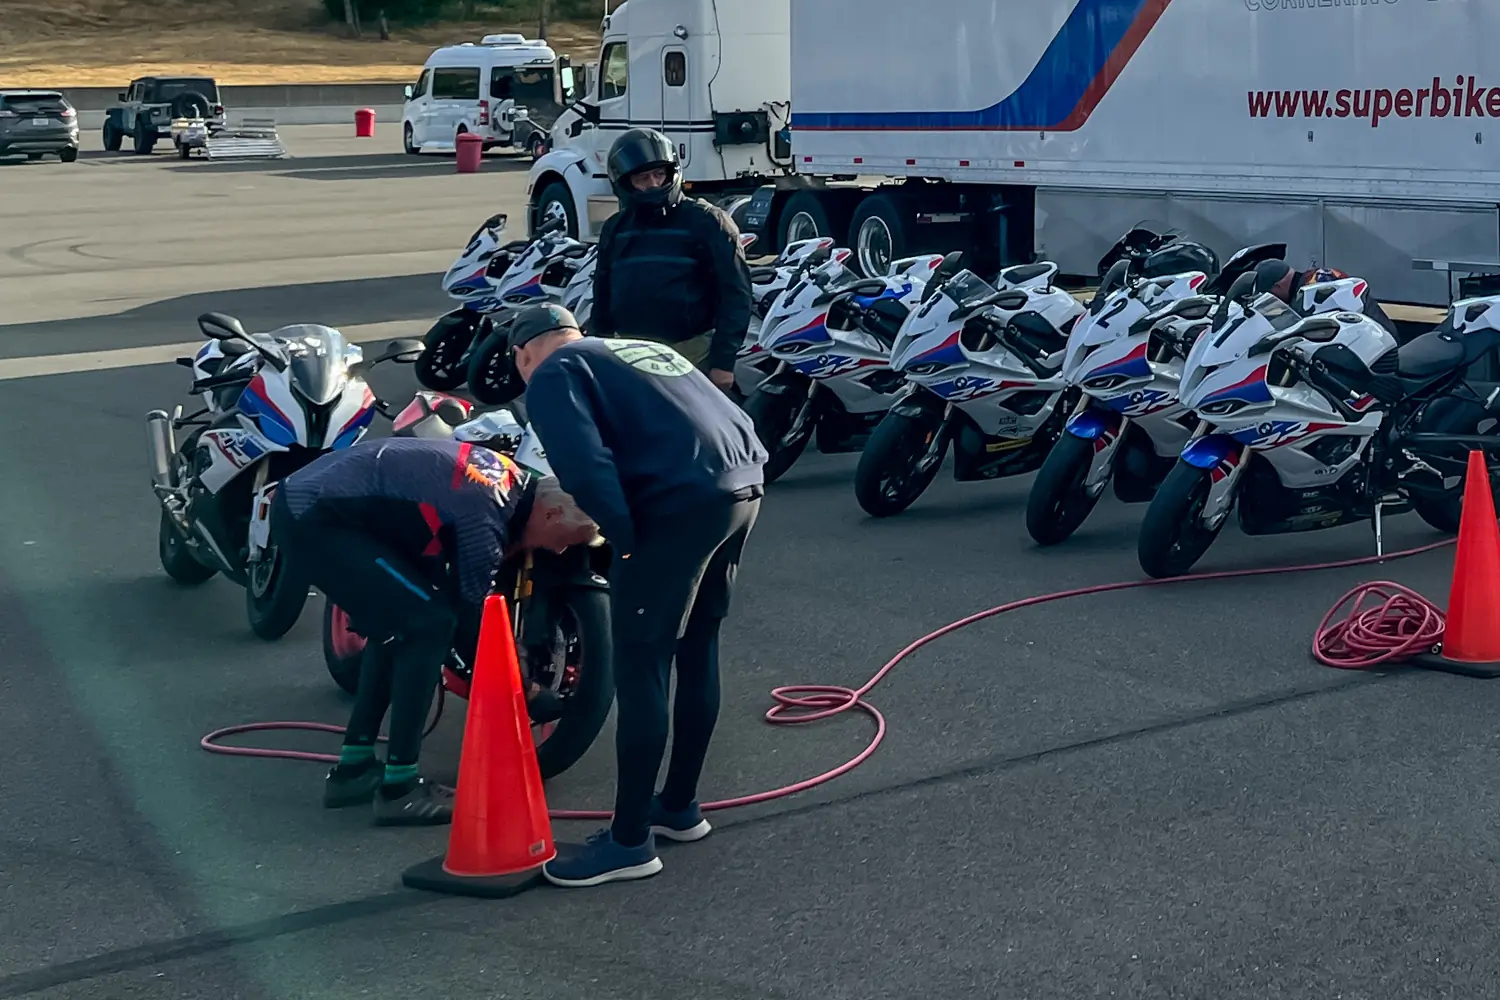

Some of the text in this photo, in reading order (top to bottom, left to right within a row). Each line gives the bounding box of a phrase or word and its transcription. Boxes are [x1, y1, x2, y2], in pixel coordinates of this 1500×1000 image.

[918, 291, 943, 318] 3
[1096, 297, 1128, 329] 2
[1213, 317, 1248, 349] 1
